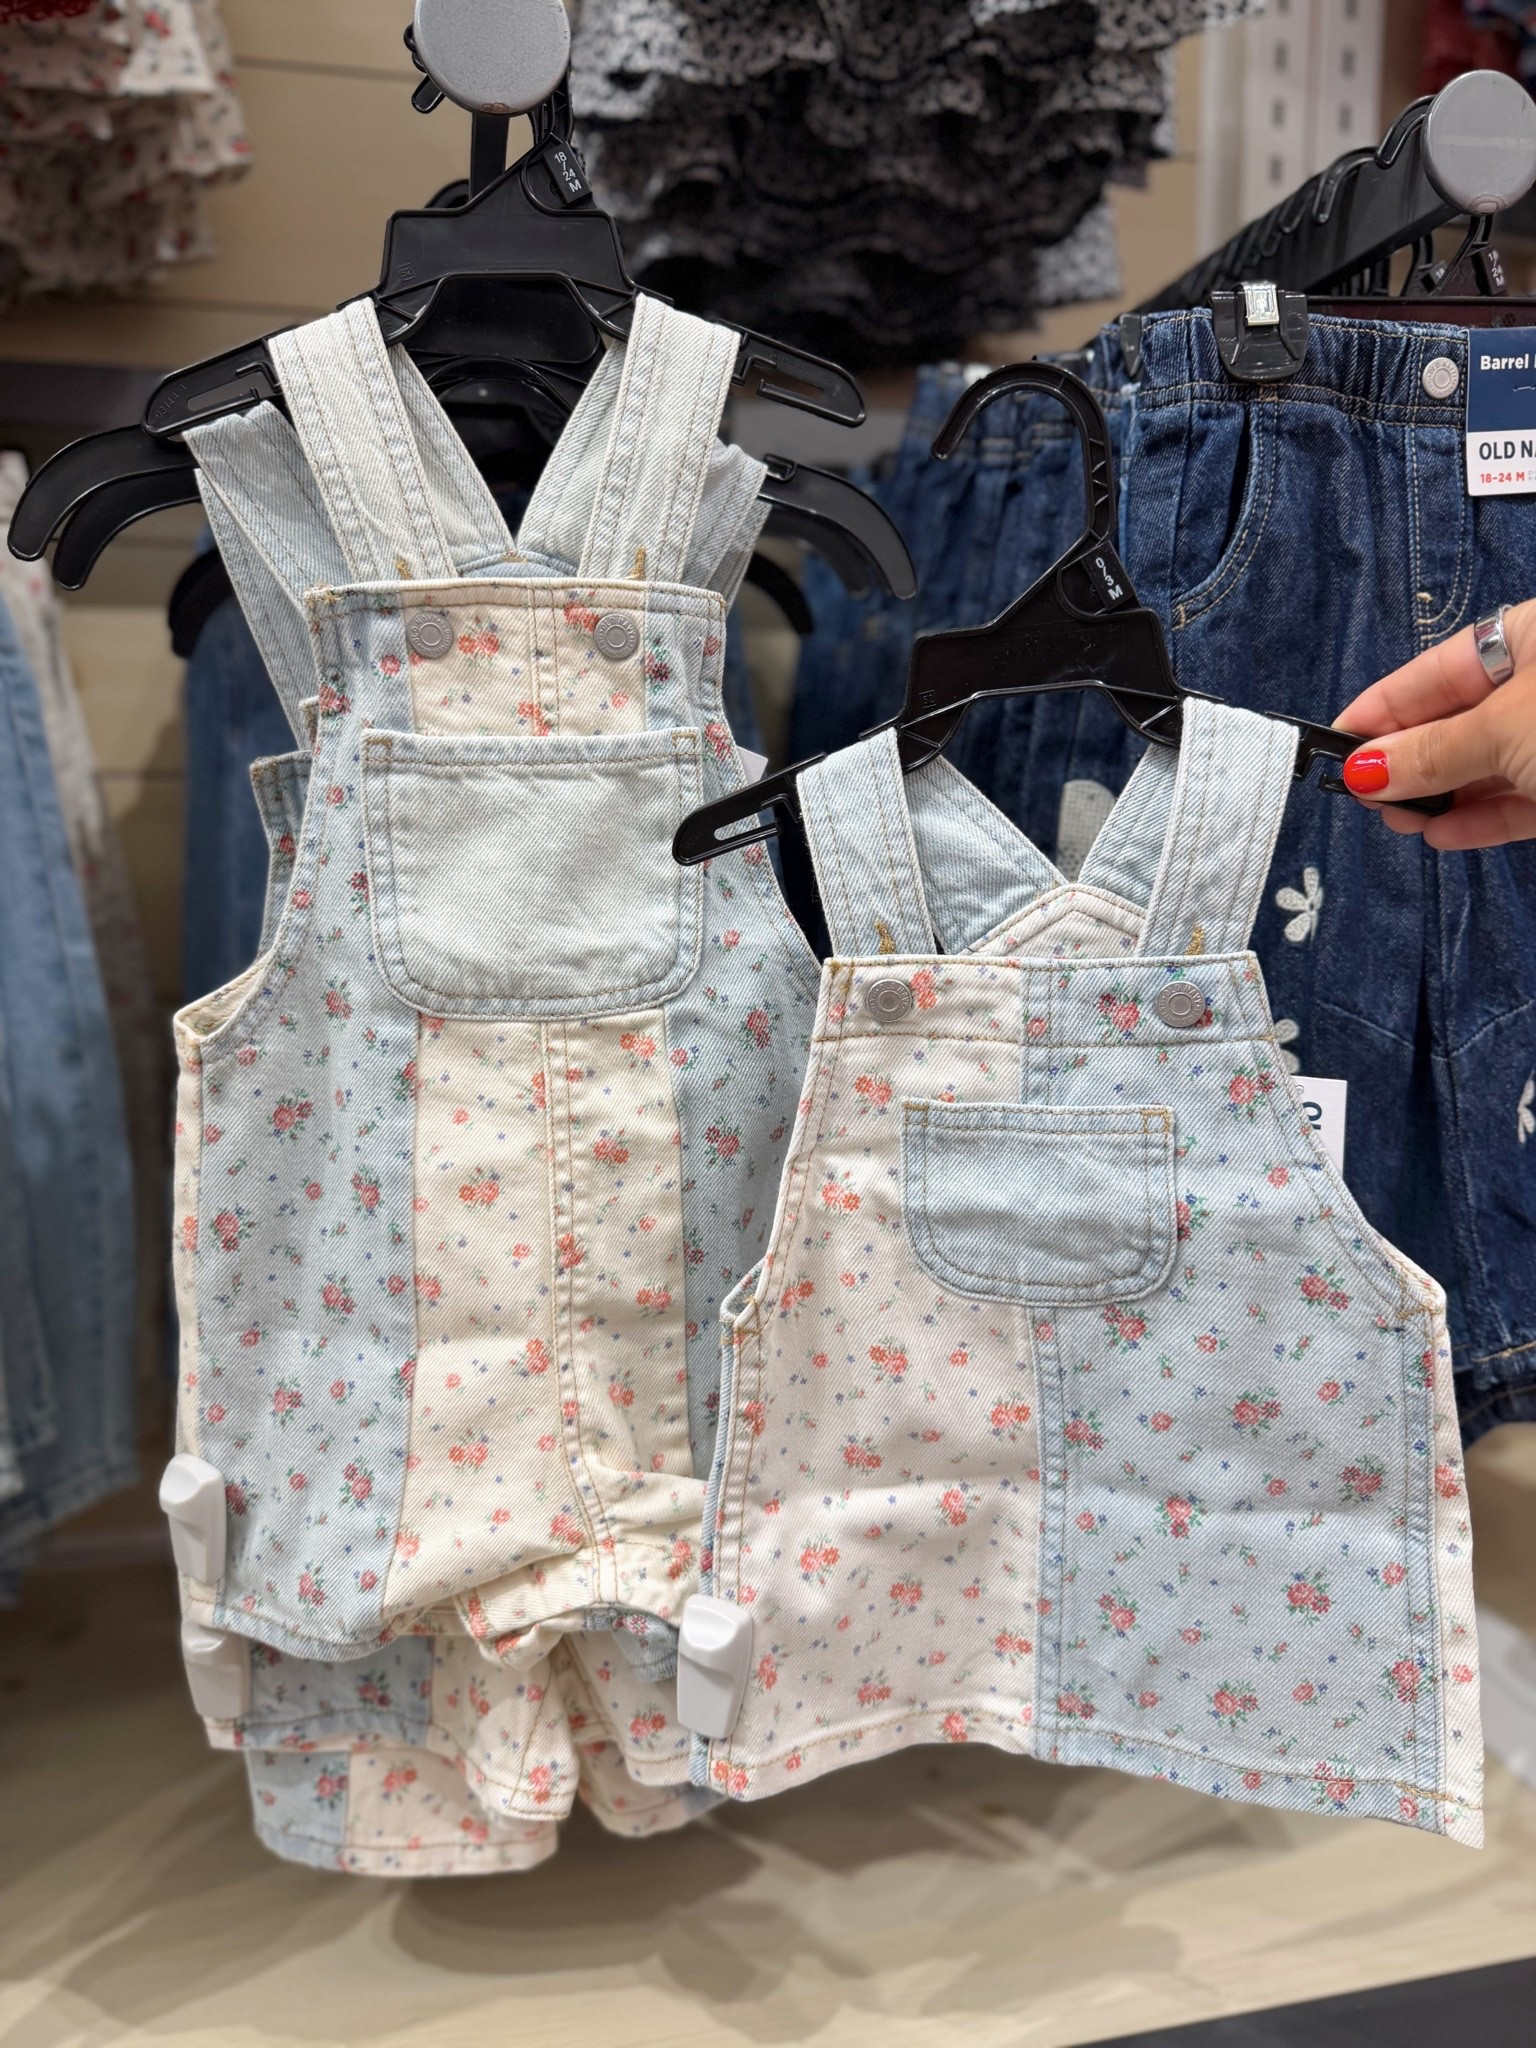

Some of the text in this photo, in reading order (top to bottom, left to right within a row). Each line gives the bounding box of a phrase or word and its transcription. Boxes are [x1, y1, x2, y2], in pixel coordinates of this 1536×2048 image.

[554, 151, 567, 164] 18
[563, 168, 576, 181] 24
[568, 179, 582, 193] M
[1480, 353, 1529, 371] Barrel
[1479, 441, 1516, 461] OLD
[1480, 472, 1512, 484] 18-24
[1516, 471, 1525, 482] M
[1105, 575, 1115, 586] 3
[1107, 584, 1123, 601] M
